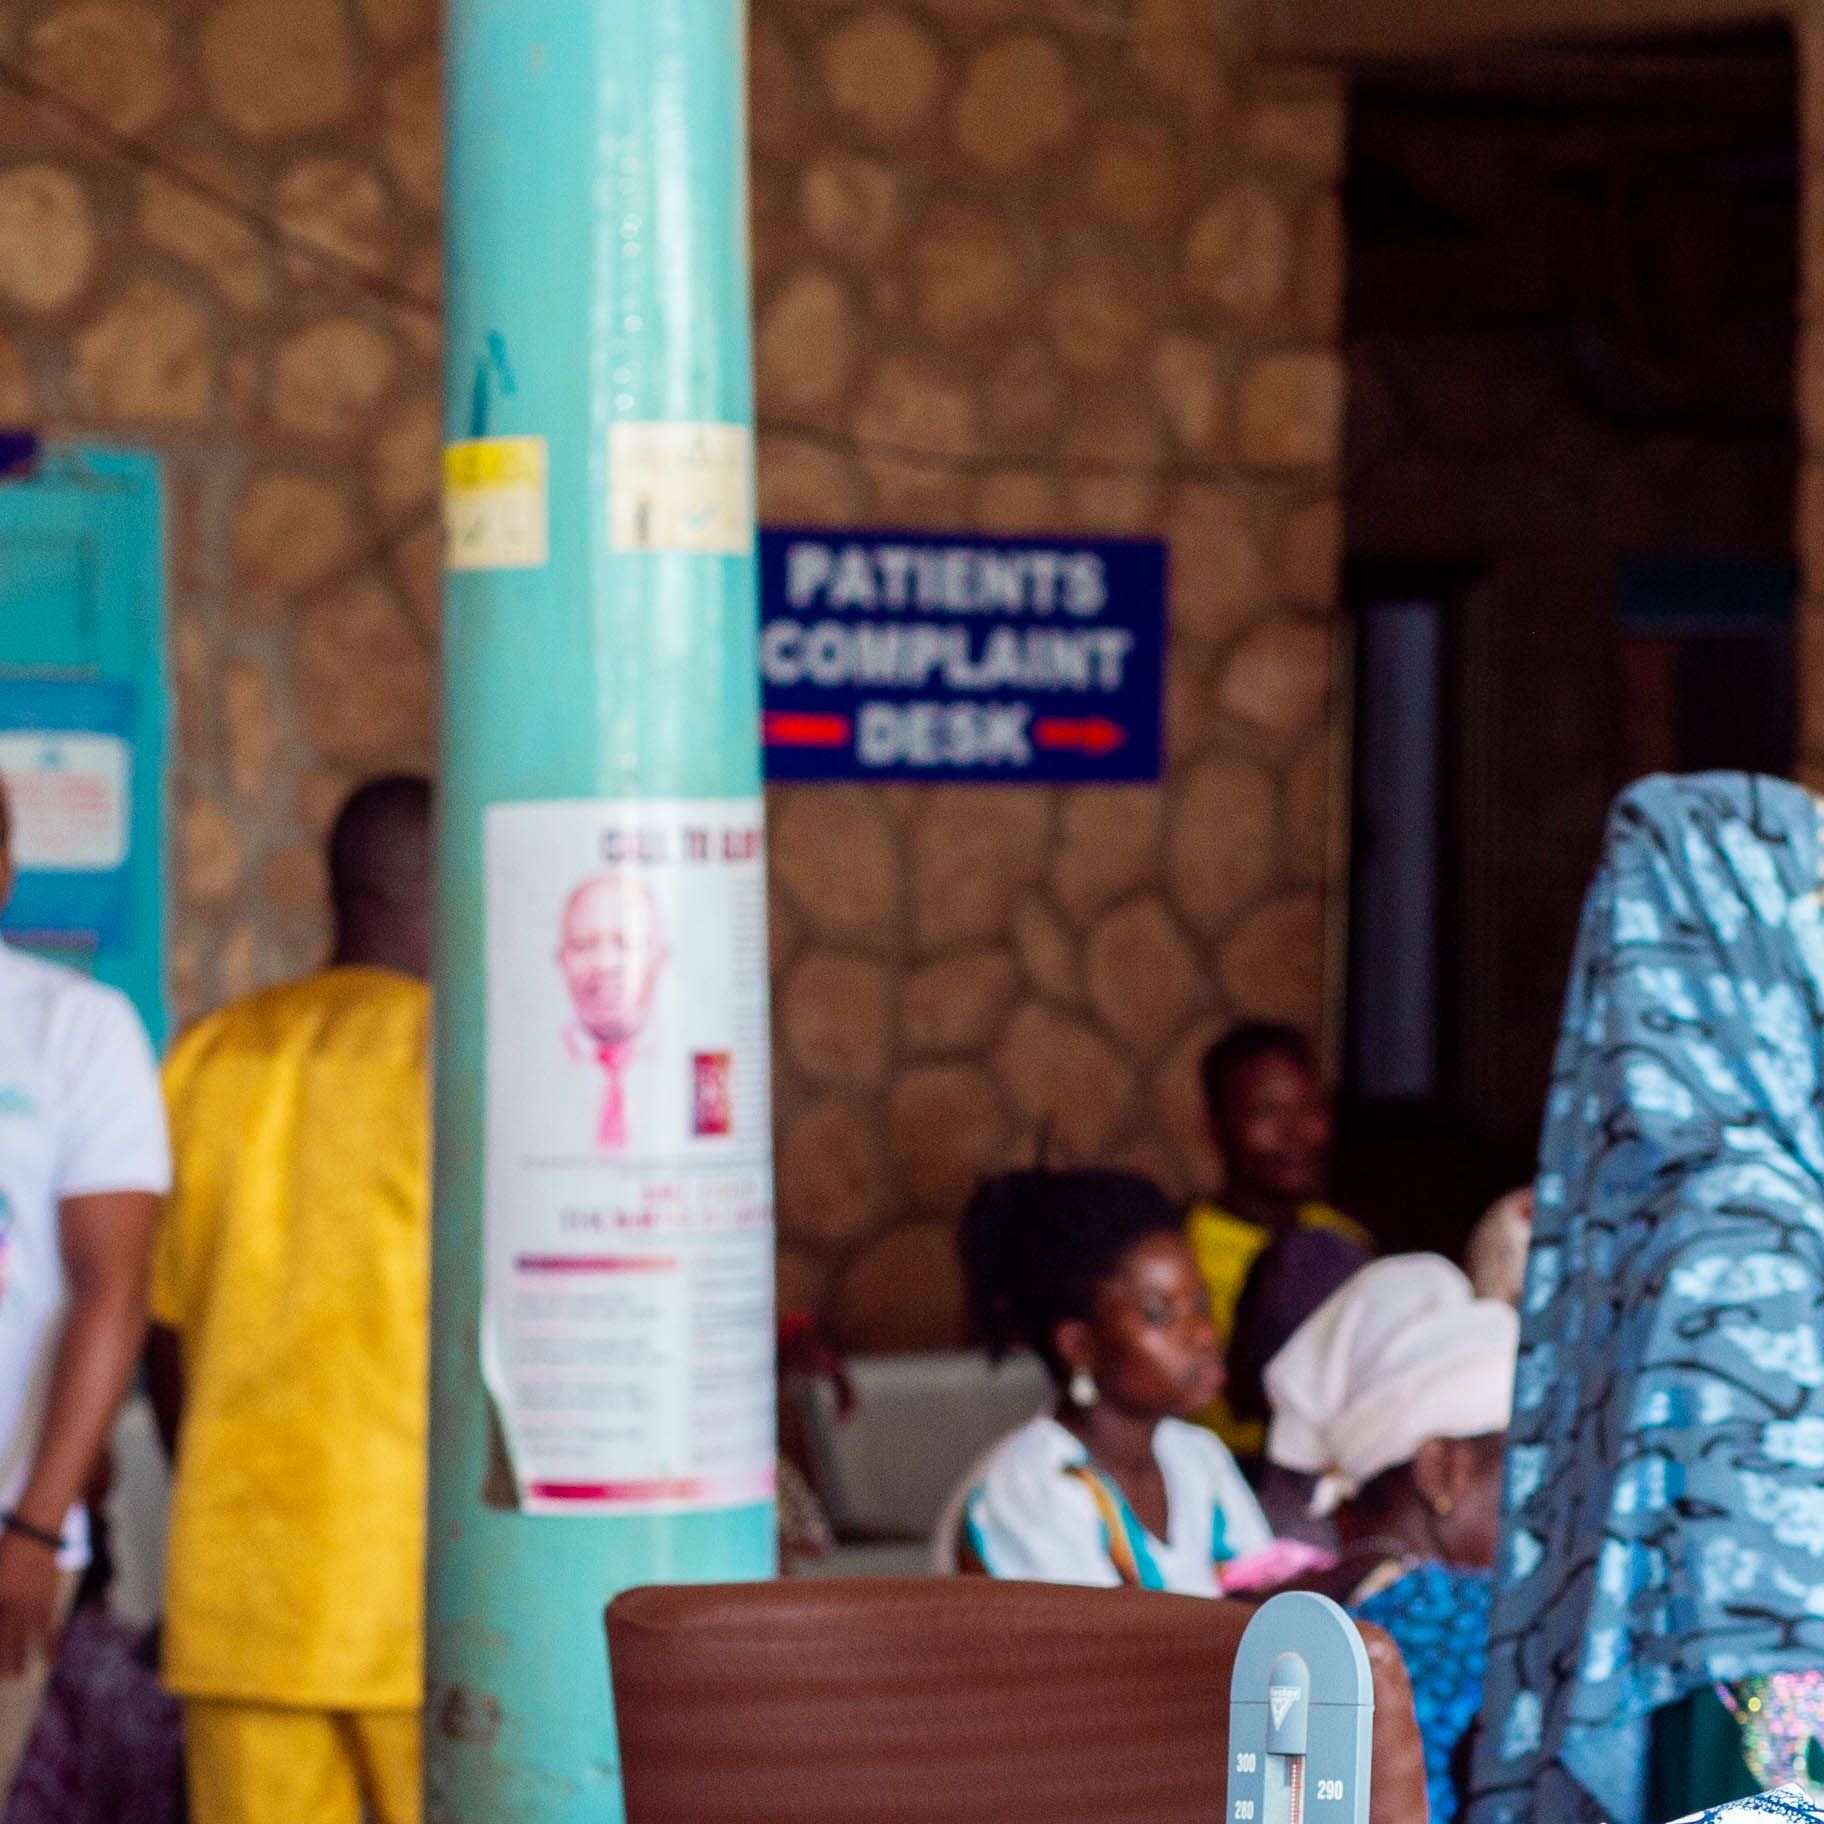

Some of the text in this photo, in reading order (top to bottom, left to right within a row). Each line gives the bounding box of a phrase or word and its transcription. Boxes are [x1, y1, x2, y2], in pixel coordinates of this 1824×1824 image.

[786, 542, 1107, 616] PATIENTS
[760, 619, 1133, 692] COMPLAINT
[856, 701, 1034, 767] DESK
[1236, 1752, 1256, 1773] 300
[1234, 1800, 1254, 1820] 280
[1317, 1780, 1343, 1800] 290
